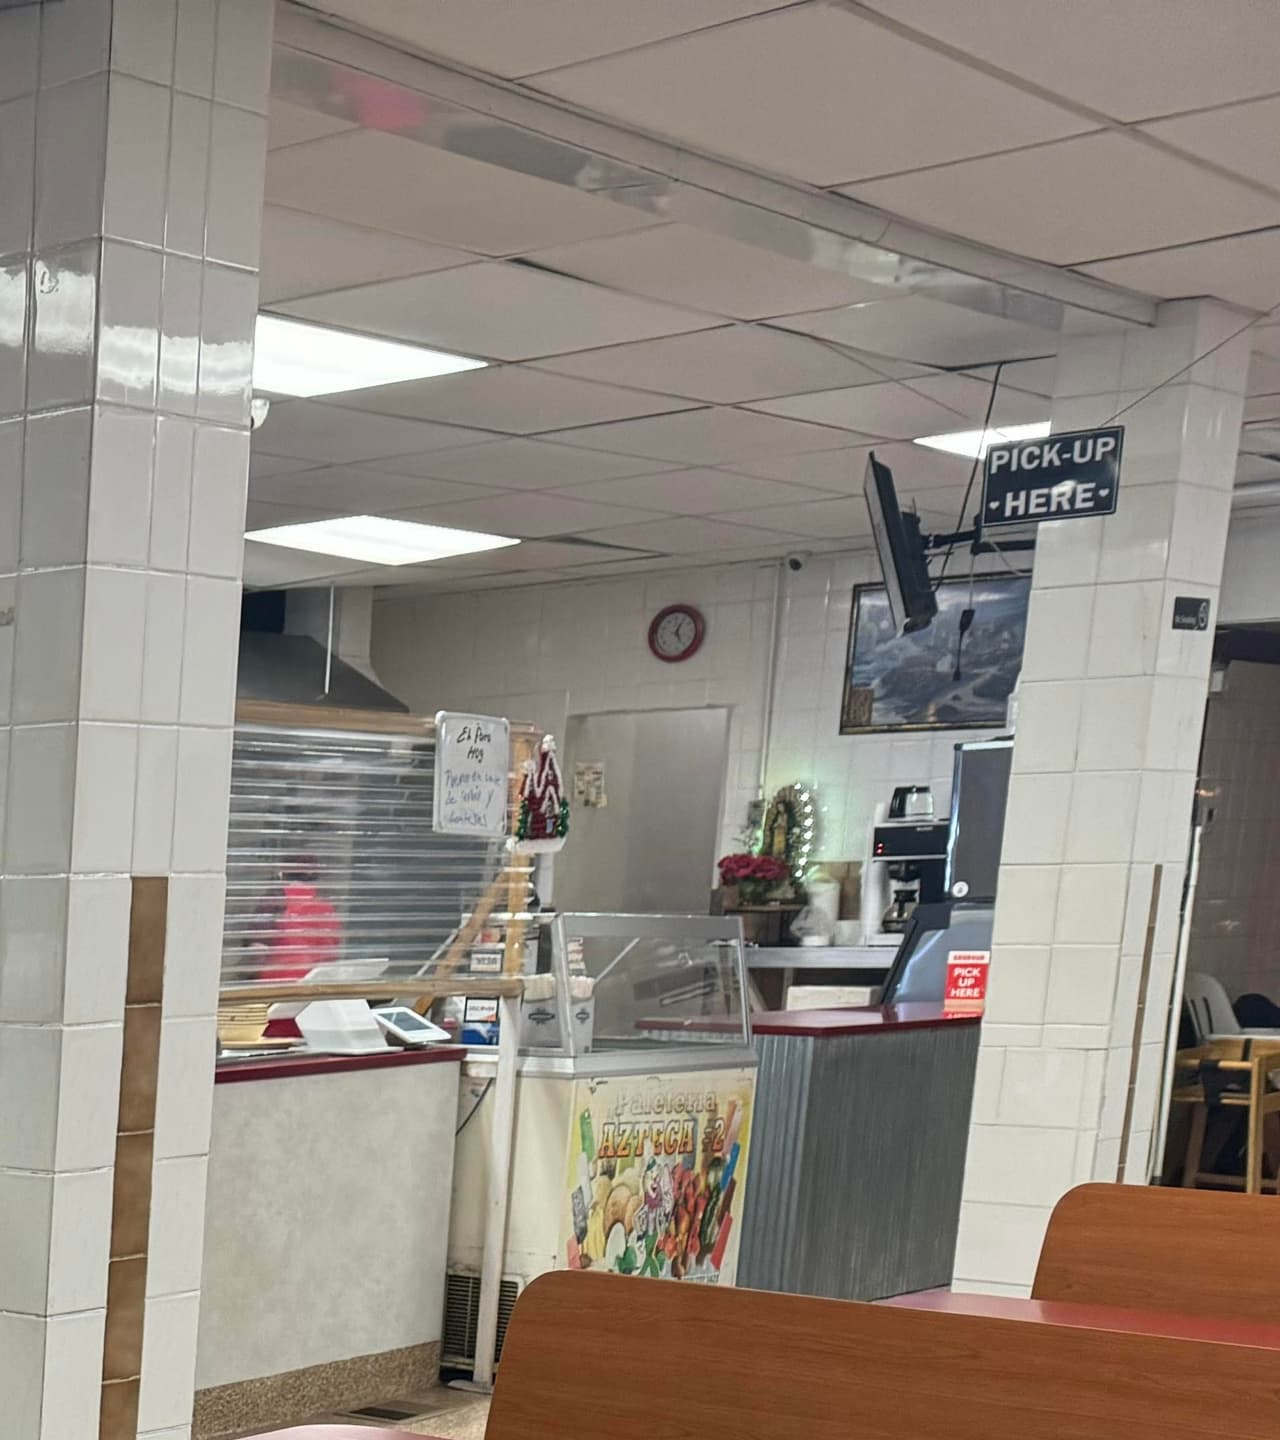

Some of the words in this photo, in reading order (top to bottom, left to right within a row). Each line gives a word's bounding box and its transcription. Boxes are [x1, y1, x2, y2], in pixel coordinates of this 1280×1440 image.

[990, 436, 1116, 475] PICK-UP
[1004, 481, 1097, 518] HERE
[953, 967, 981, 977] PICK
[958, 977, 975, 987] UP
[950, 988, 980, 997] HERE
[598, 1119, 696, 1159] AZTECA
